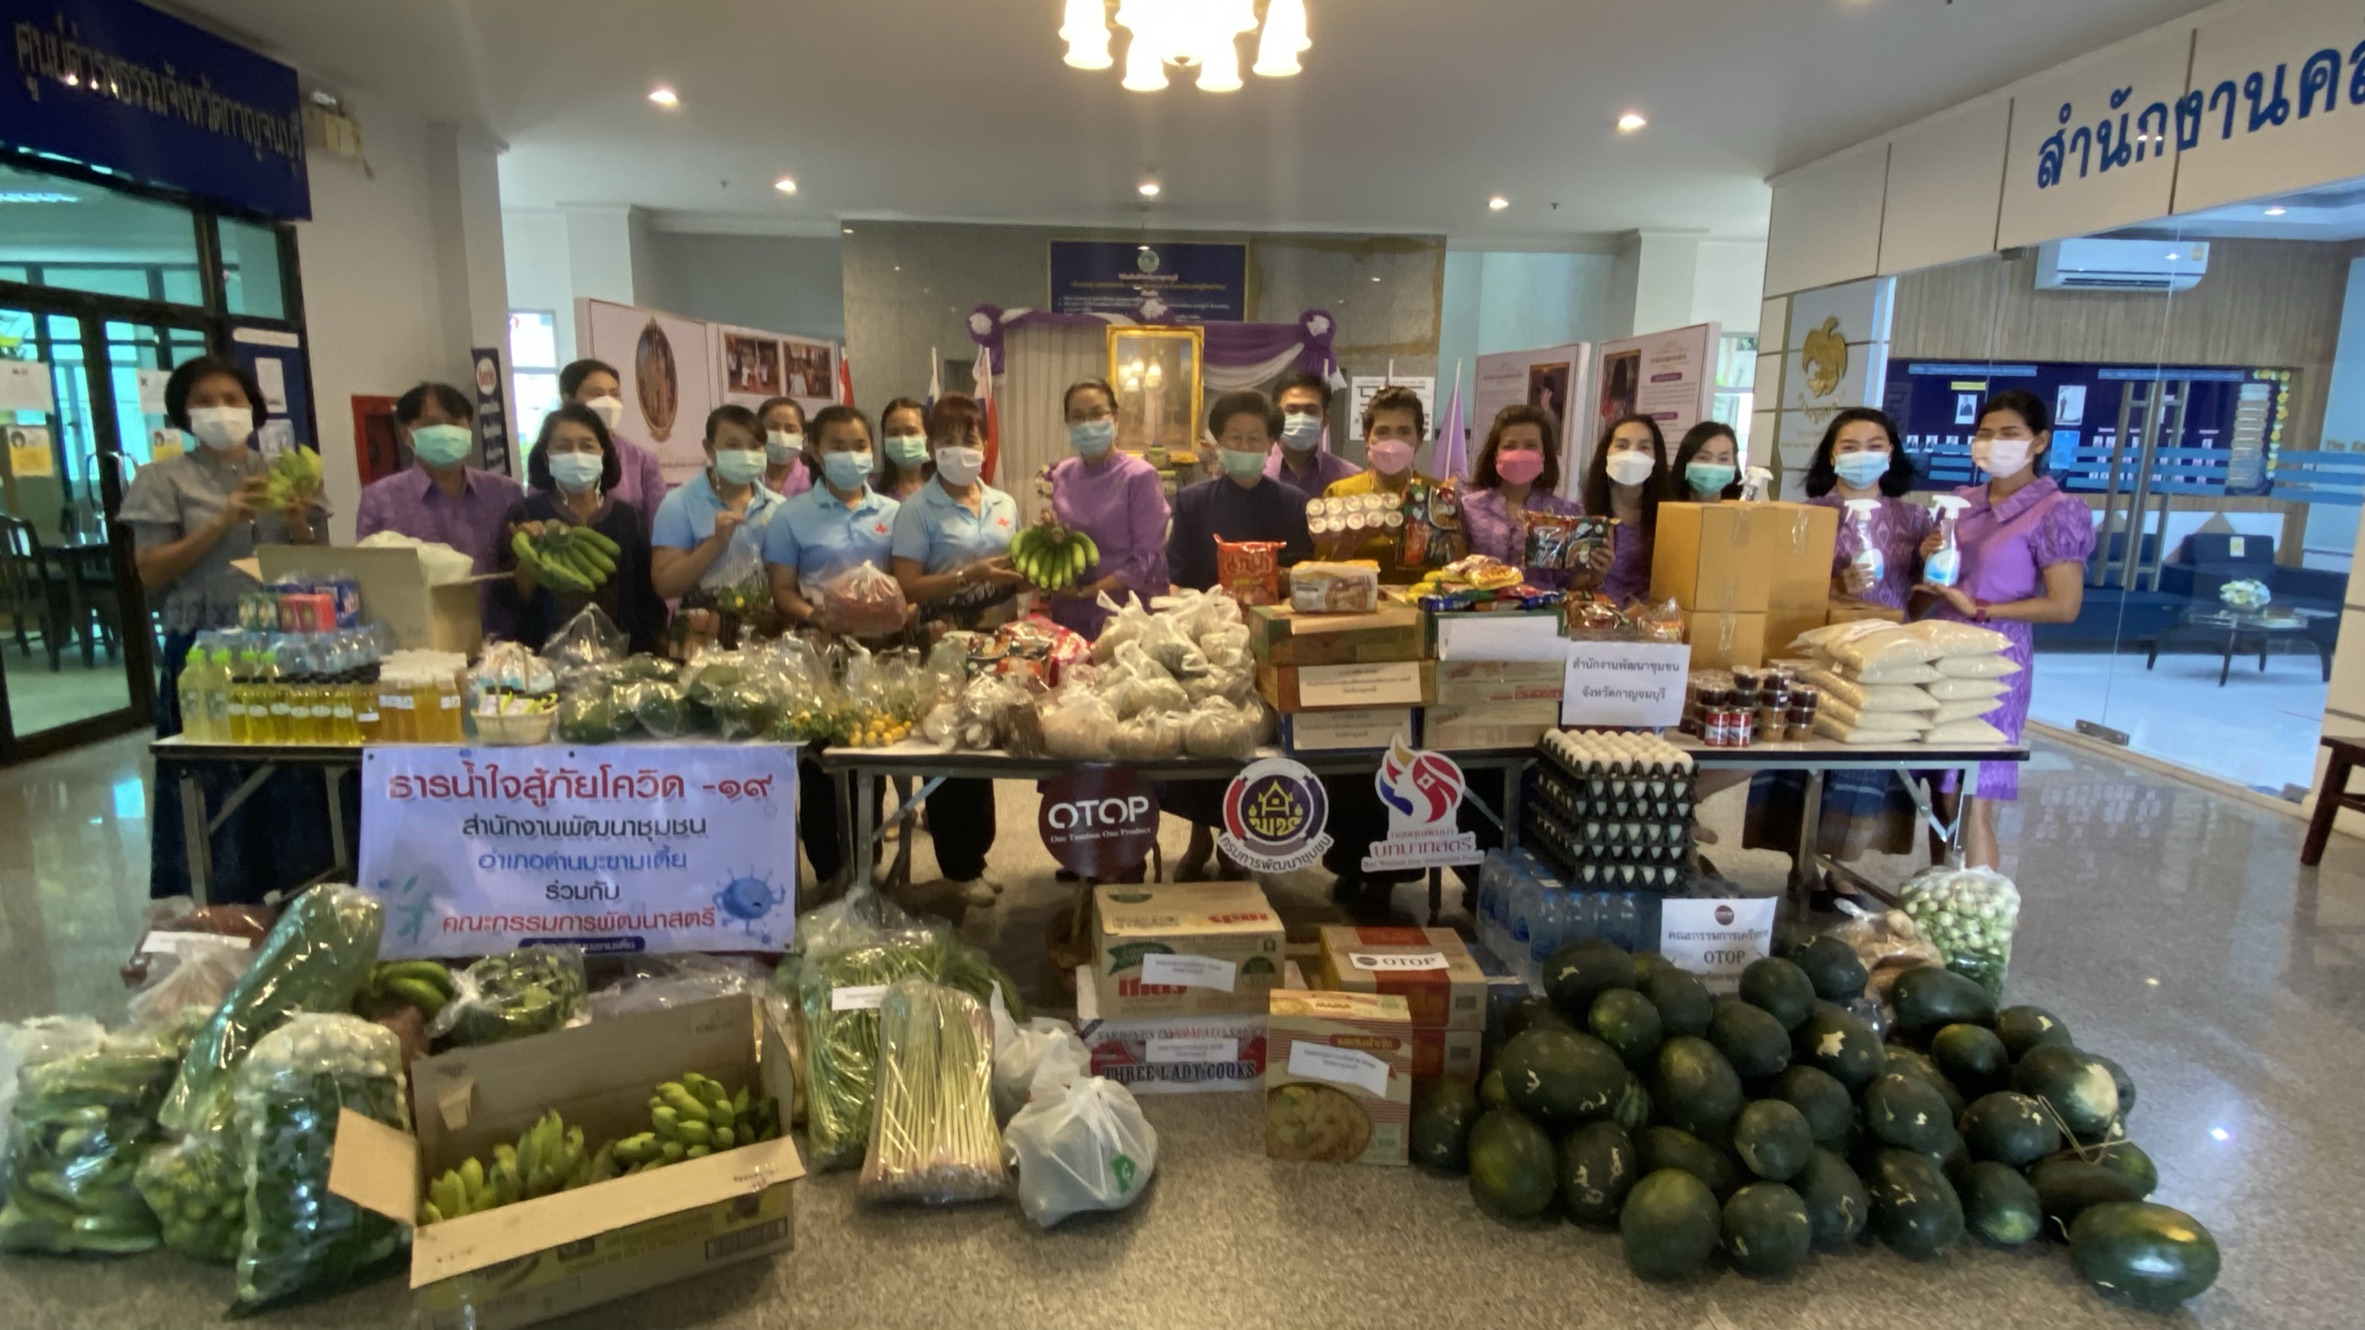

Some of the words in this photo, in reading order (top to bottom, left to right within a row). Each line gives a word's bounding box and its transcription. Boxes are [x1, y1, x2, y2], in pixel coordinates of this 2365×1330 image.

[1572, 657, 1680, 675] สำนักงานพัฒนาชุมชน
[1582, 686, 1666, 703] จังหวัดกาญจนบุรี
[389, 760, 685, 808] ธารน้ำใจสู้ภัยโควิด
[1048, 796, 1149, 829] OTOP
[462, 813, 707, 842] สำนักงานพัฒนาชุมชน
[1050, 835, 1068, 843] One
[1102, 829, 1119, 838] One
[1120, 827, 1151, 837] Product
[478, 843, 687, 870] อำเภอด่านมะขามเตี้ย
[1221, 836, 1331, 871] กรมการพัฒนาชุมชน
[1373, 836, 1472, 857] บทบาทสตรี
[545, 880, 620, 901] ร่วมกับ
[443, 906, 716, 933] คณะกรรมการพัฒนาสตรี
[1383, 957, 1436, 966] OTOP
[1704, 950, 1745, 964] OTOP
[1104, 1064, 1155, 1082] THREE
[1160, 1063, 1204, 1081] LADY
[1206, 1062, 1257, 1080] COOKS
